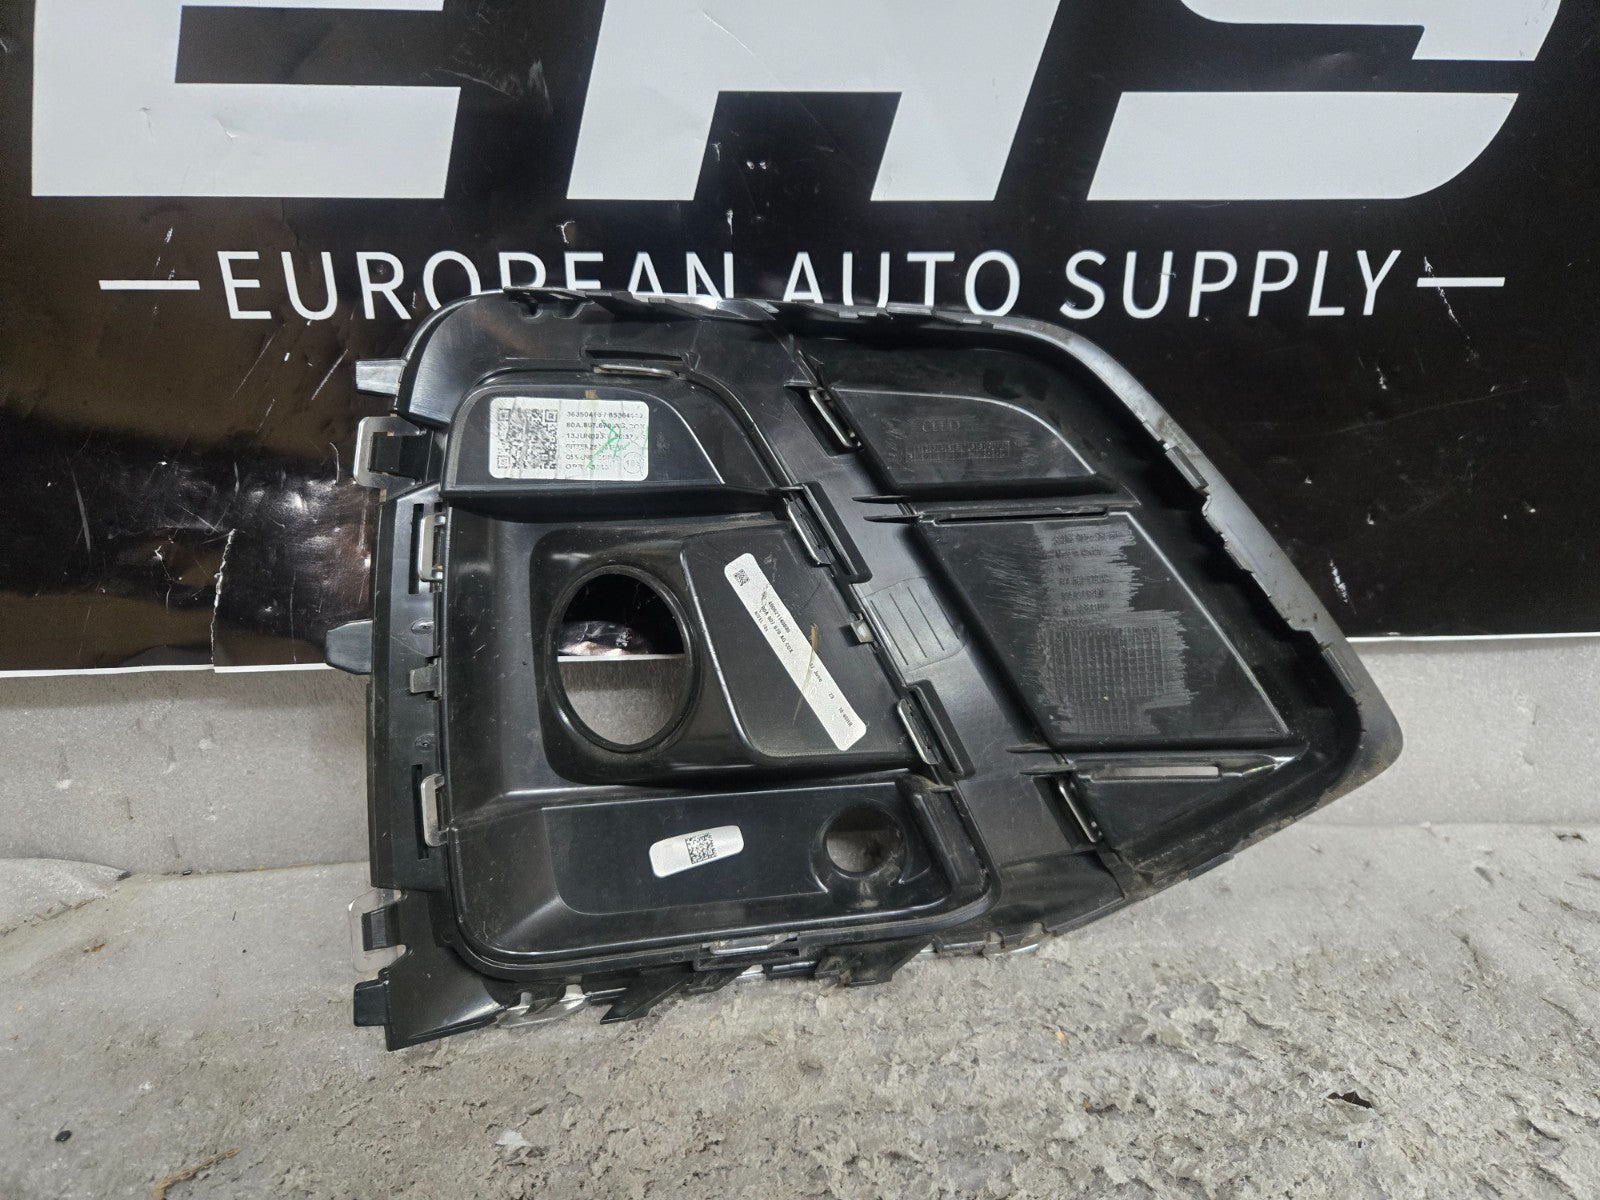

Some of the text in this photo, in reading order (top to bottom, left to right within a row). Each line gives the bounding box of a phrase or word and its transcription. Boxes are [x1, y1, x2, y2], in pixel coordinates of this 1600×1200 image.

[217, 249, 1402, 320] EUROPEAN AUTO SUPPLY
